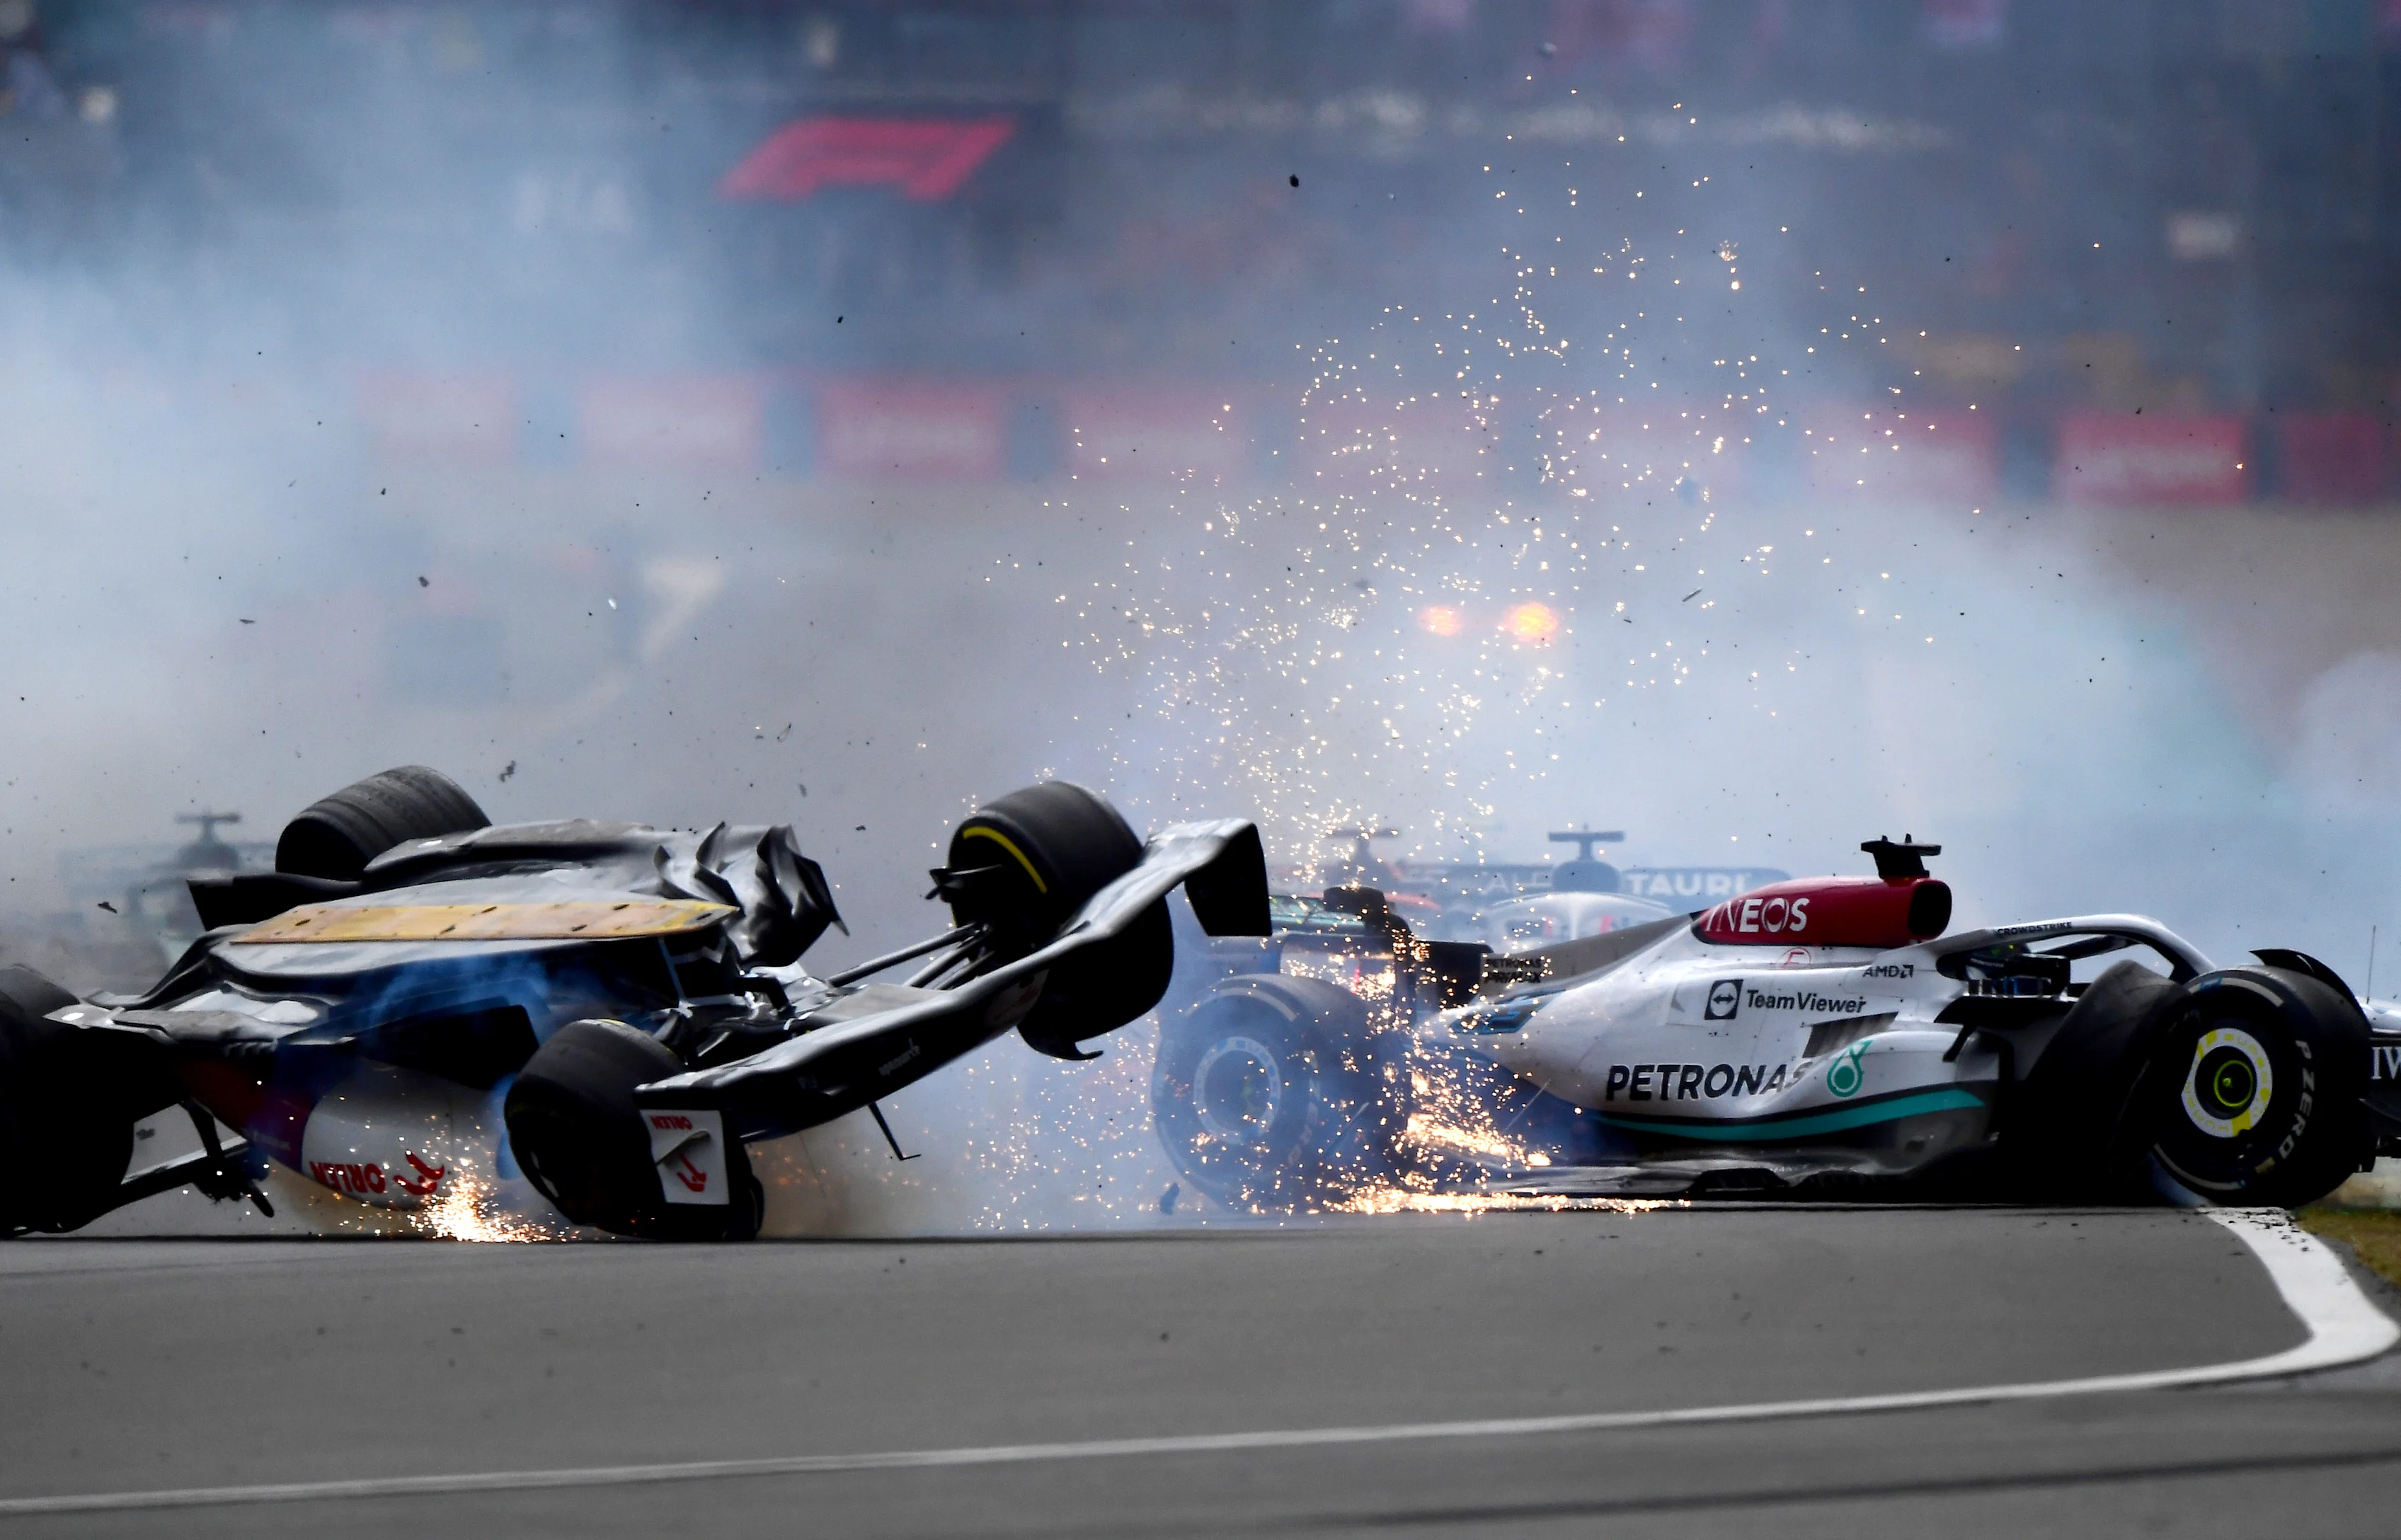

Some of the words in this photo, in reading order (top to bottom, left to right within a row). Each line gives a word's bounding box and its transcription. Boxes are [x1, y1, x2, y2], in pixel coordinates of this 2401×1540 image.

[1629, 872, 1747, 897] TAURI
[1704, 897, 1810, 933] INEOS
[1997, 921, 2073, 936] CROWDSTRIKE
[1862, 966, 1898, 978] AMD
[1747, 989, 1867, 1013] TeamViewer
[1605, 1062, 1814, 1101] PETRONAS
[309, 1161, 386, 1194] ORLEN
